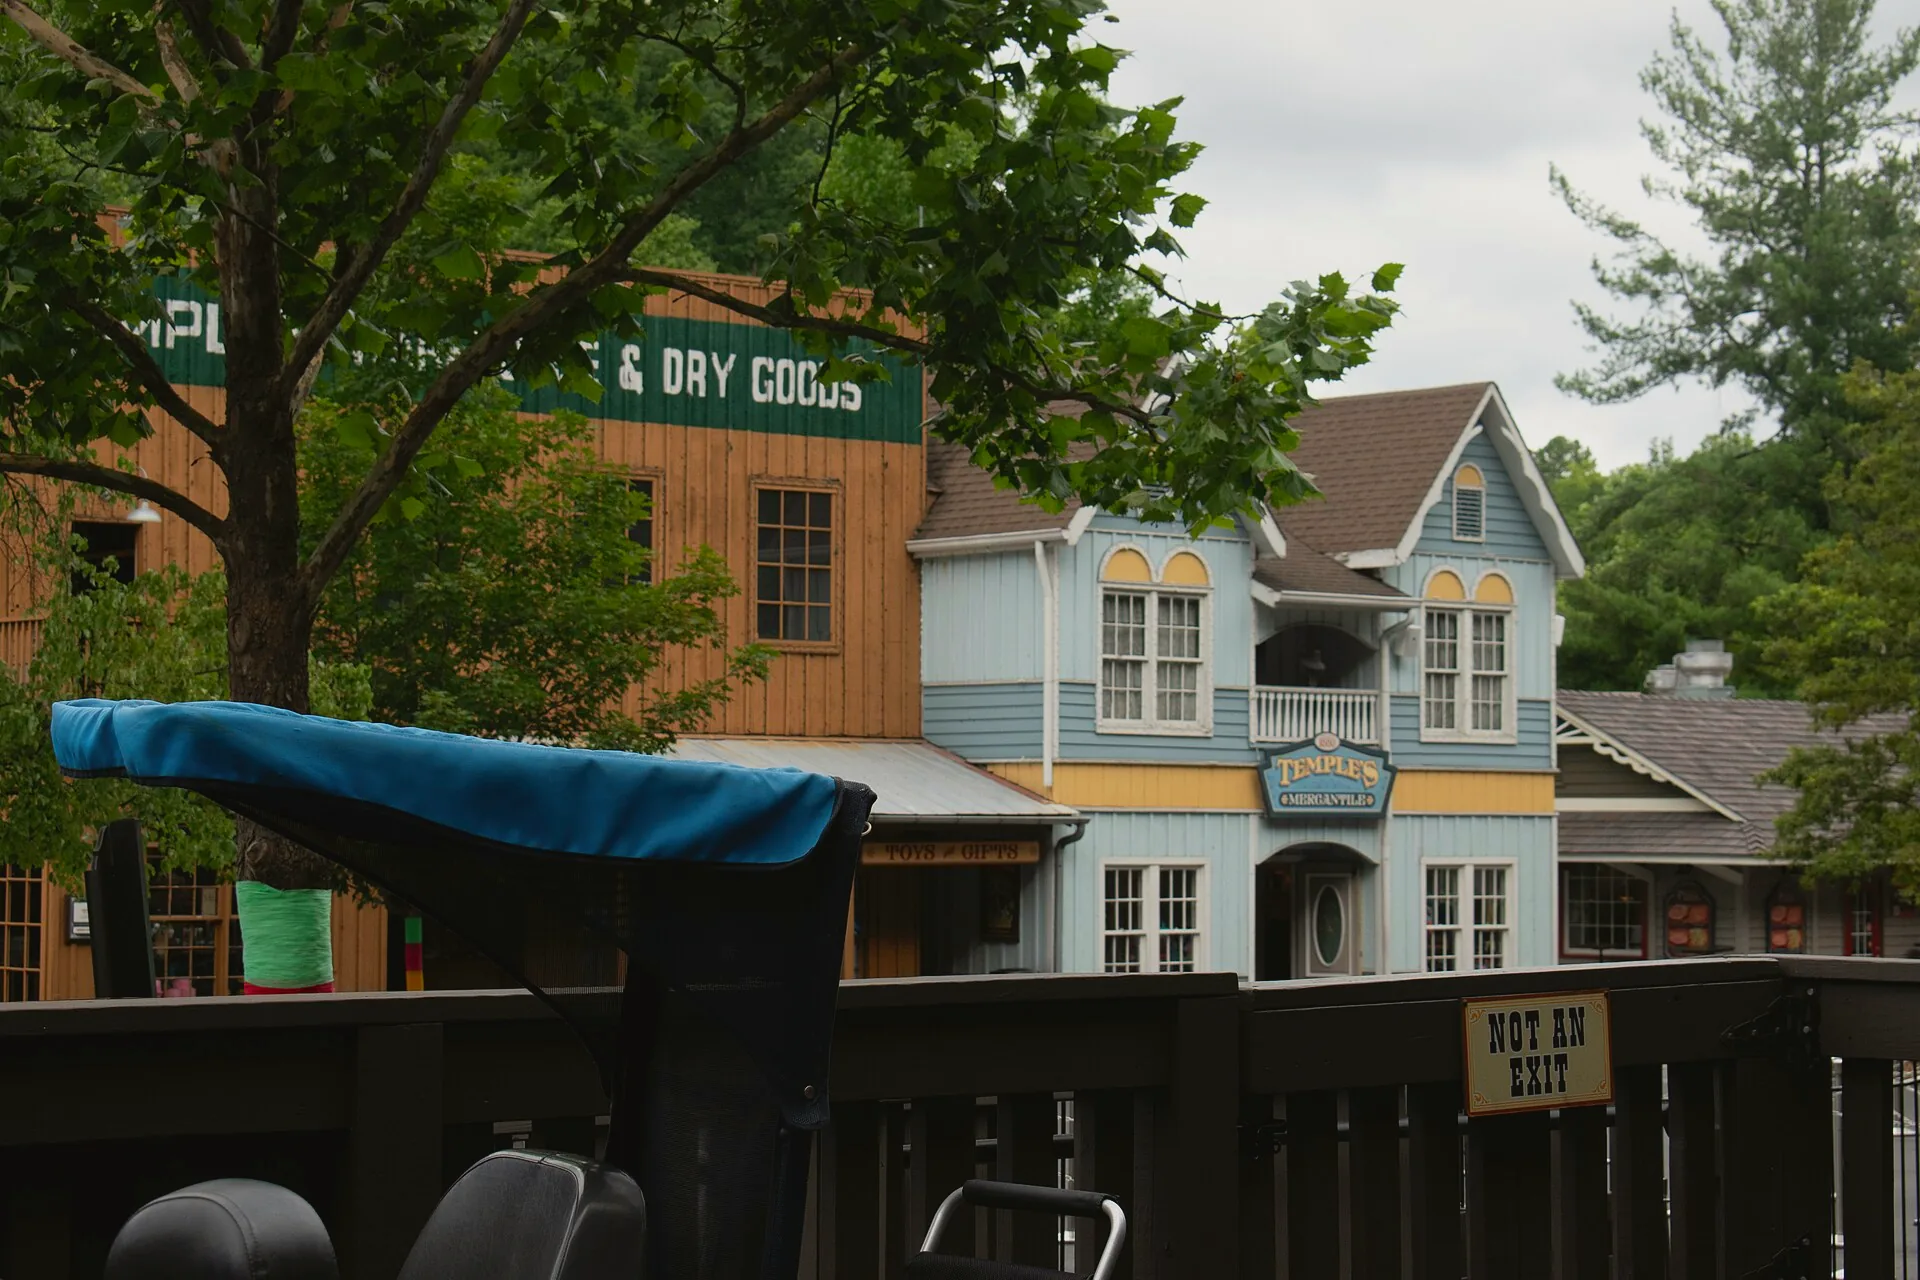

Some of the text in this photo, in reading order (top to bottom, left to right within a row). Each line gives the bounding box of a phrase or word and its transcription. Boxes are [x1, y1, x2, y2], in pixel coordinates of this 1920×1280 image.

[619, 343, 644, 395] &
[662, 347, 737, 398] DRY
[751, 356, 862, 411] GOODS
[1277, 755, 1379, 788] TEMPLE'S
[1289, 794, 1366, 806] MERCANTILE
[885, 844, 936, 861] TOYS
[961, 844, 1018, 861] GIFTS
[1488, 1006, 1585, 1054] NOT AN
[1509, 1053, 1568, 1097] EXIT
